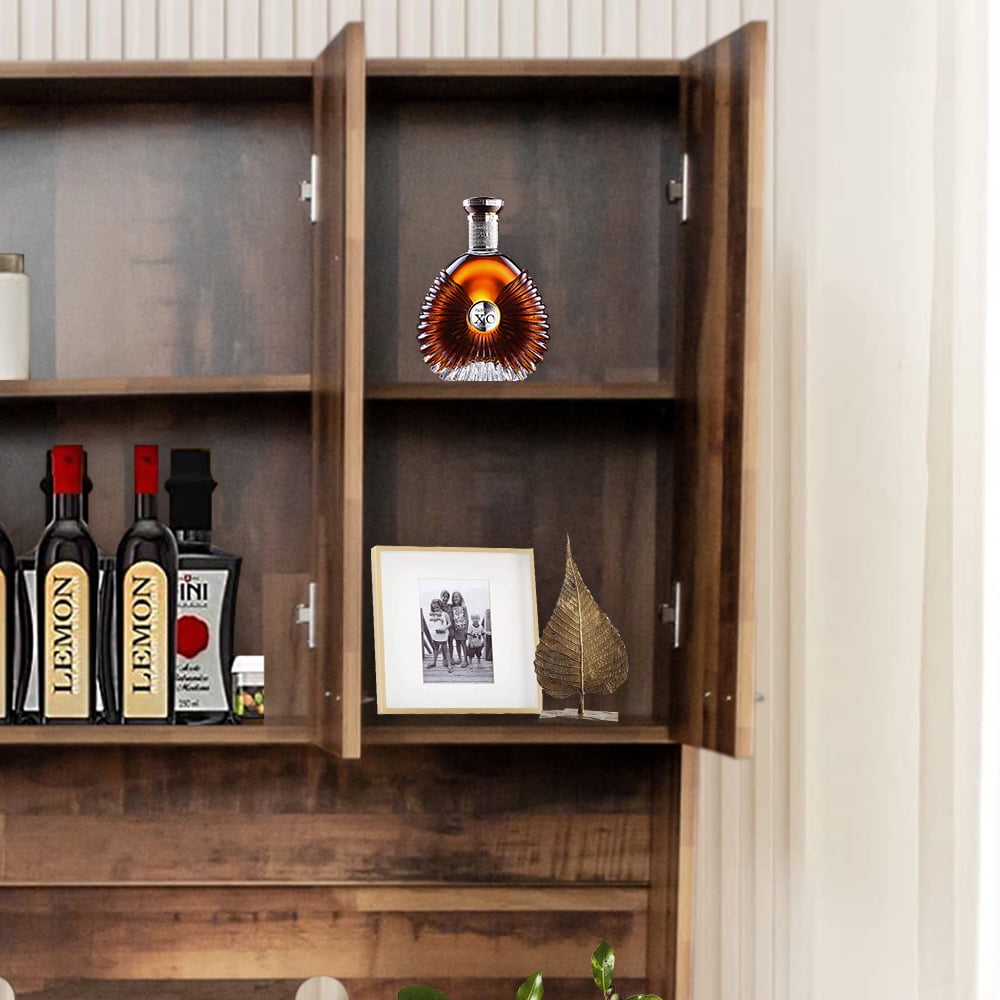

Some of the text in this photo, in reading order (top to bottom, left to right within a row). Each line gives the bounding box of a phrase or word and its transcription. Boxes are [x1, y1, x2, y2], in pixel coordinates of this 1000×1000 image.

[53, 576, 72, 694] LEMON
[132, 576, 151, 694] LEMON
[179, 583, 208, 601] INI
